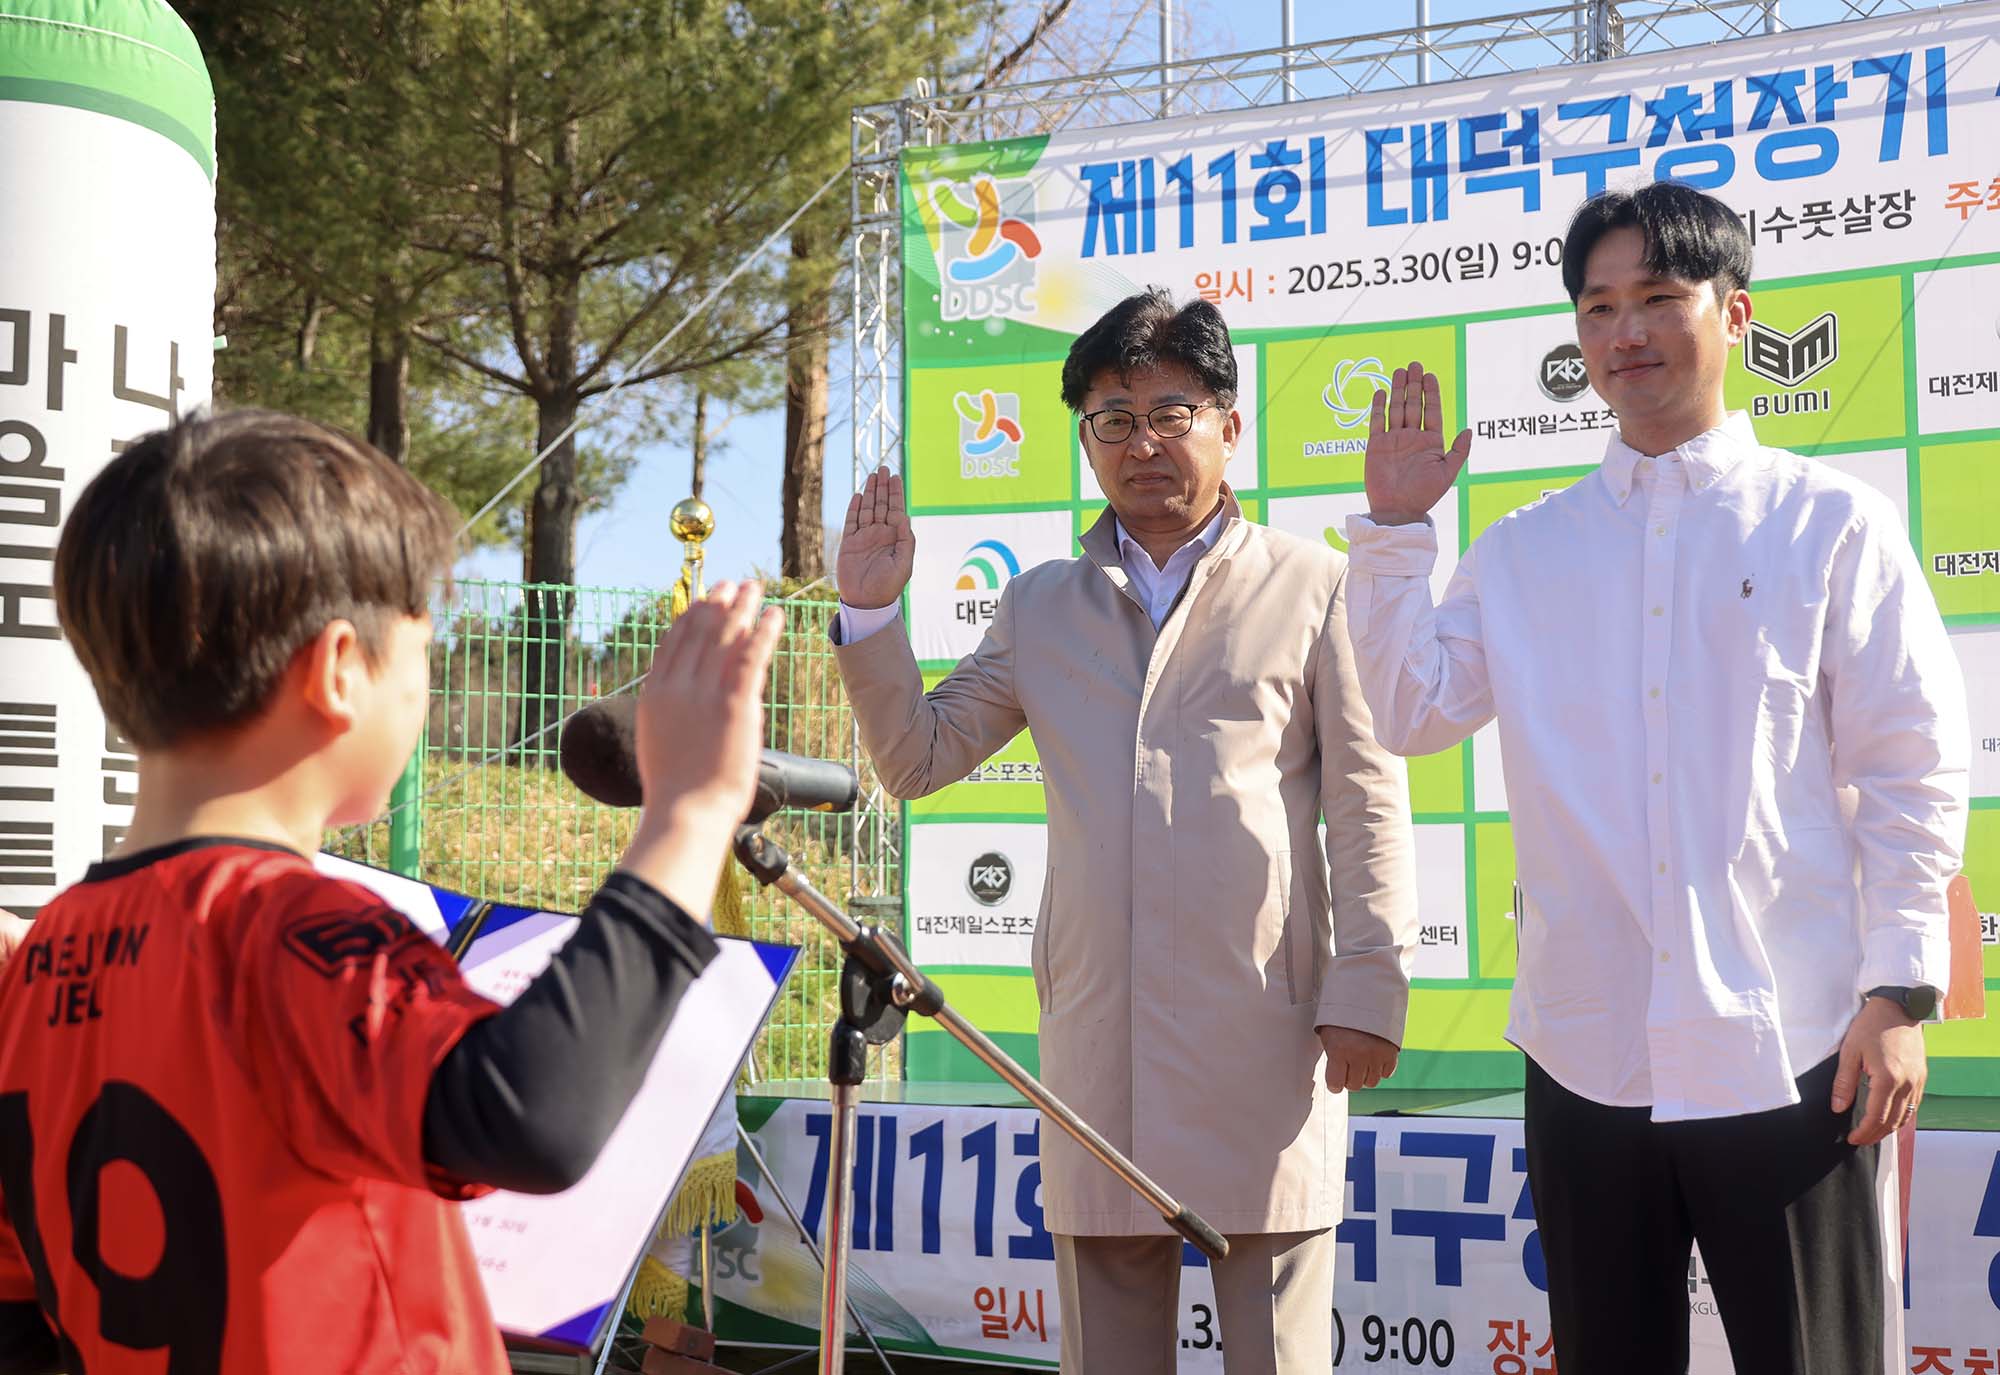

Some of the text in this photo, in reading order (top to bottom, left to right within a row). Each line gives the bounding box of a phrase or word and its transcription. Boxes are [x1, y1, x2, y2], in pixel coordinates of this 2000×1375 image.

[1080, 46, 1949, 258] 제11회 대덕구청장기
[1195, 267, 1253, 304] 일시
[1288, 242, 1499, 295] 2025.3.30(일)
[1513, 237, 1564, 270] 9:0
[944, 282, 1036, 317] DDSC
[1753, 390, 1830, 417] BUMI
[1304, 439, 1367, 456] DAEHAN
[962, 455, 1020, 477] DDSC
[1419, 925, 1458, 946] 센터
[974, 1286, 1048, 1342] 일시
[1362, 1314, 1455, 1368] 9:00
